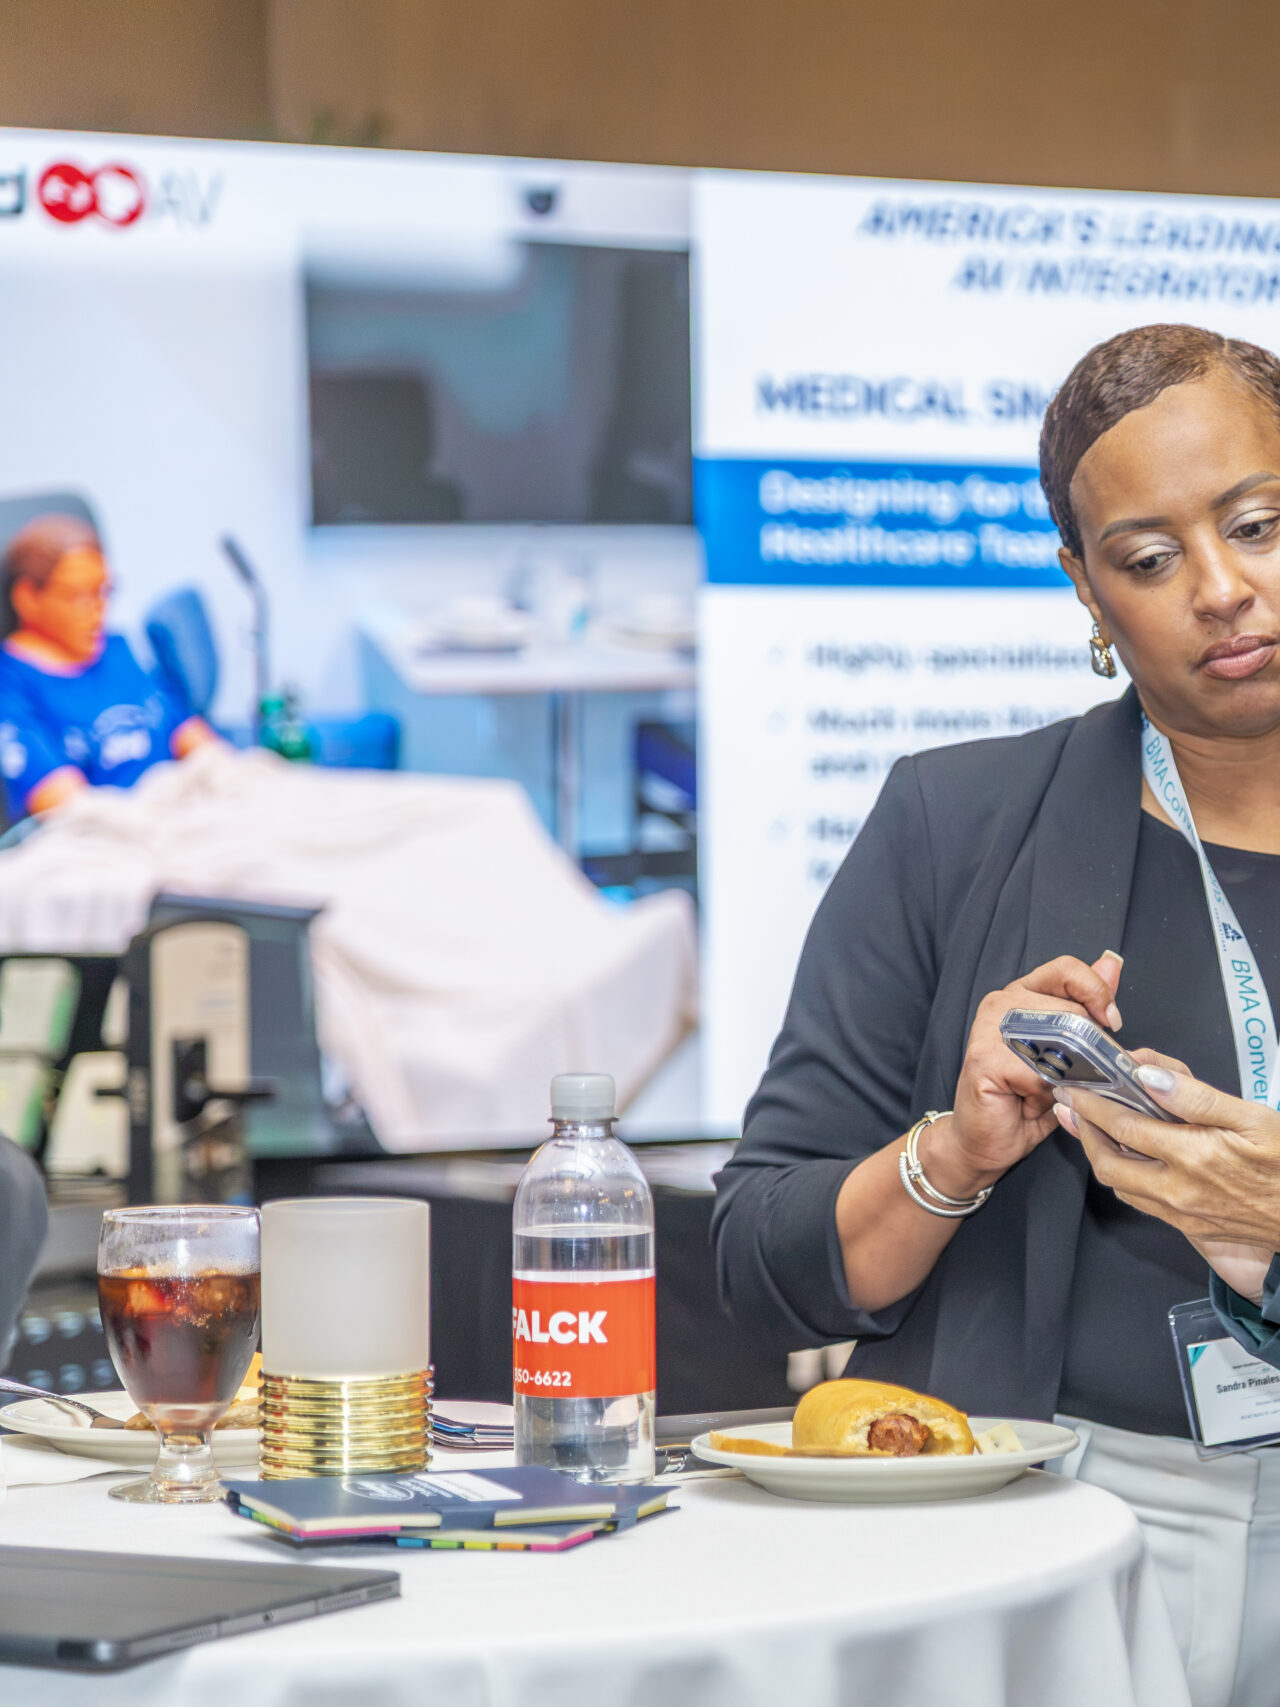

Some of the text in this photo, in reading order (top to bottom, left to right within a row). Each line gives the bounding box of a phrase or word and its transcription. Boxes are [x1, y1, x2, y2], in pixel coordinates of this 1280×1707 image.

[859, 198, 1102, 244] AMERICA'S
[757, 375, 966, 422] MEDICAL
[760, 469, 961, 524] Designing
[961, 474, 1020, 517] for
[760, 521, 976, 566] Healthcare
[1145, 736, 1169, 787] BMA
[1231, 959, 1261, 1012] BMA
[1216, 1381, 1247, 1394] Sandra
